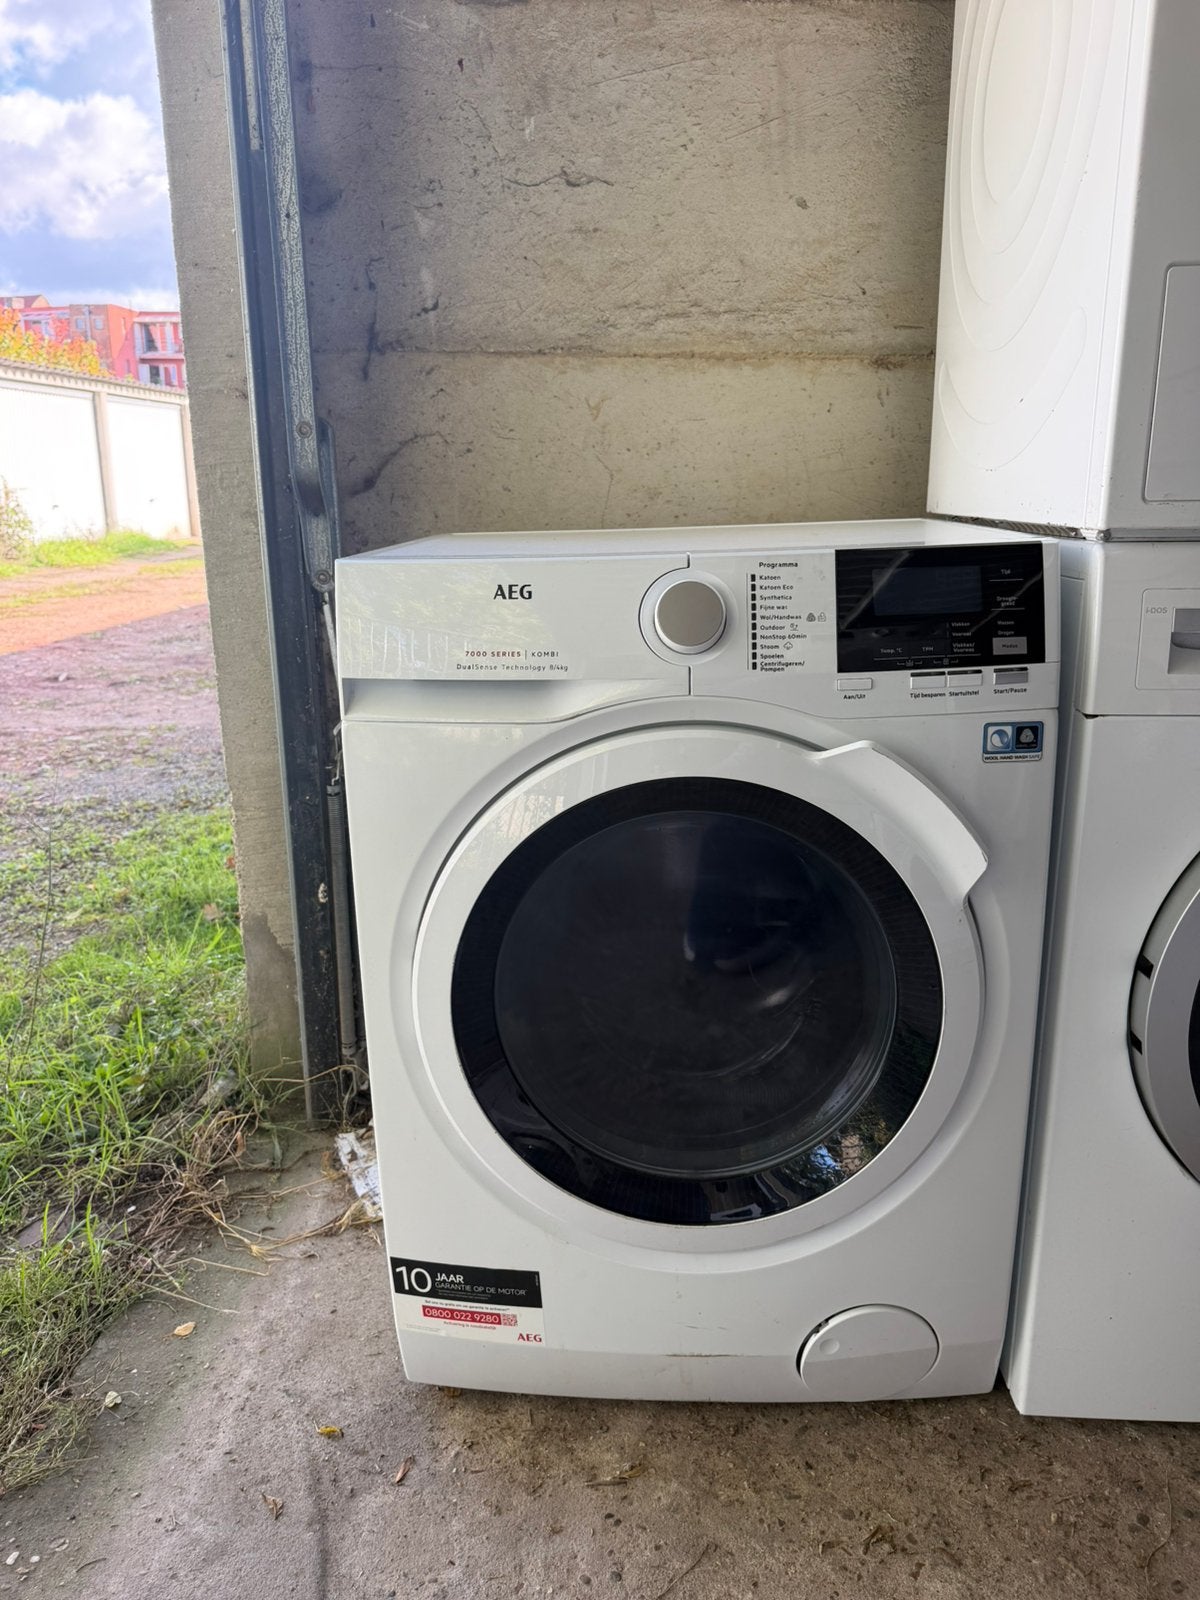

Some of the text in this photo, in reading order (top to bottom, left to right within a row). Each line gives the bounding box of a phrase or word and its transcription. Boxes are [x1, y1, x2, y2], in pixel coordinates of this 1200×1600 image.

[493, 584, 532, 600] AEG
[502, 664, 546, 672] Technology
[396, 1266, 432, 1293] 10
[434, 1272, 464, 1284] JAAR
[434, 1282, 472, 1292] GARANTIE
[473, 1285, 484, 1293] OP
[486, 1286, 496, 1294] DE
[425, 1308, 499, 1323] 0800 022 9280
[518, 1332, 542, 1343] AEG
